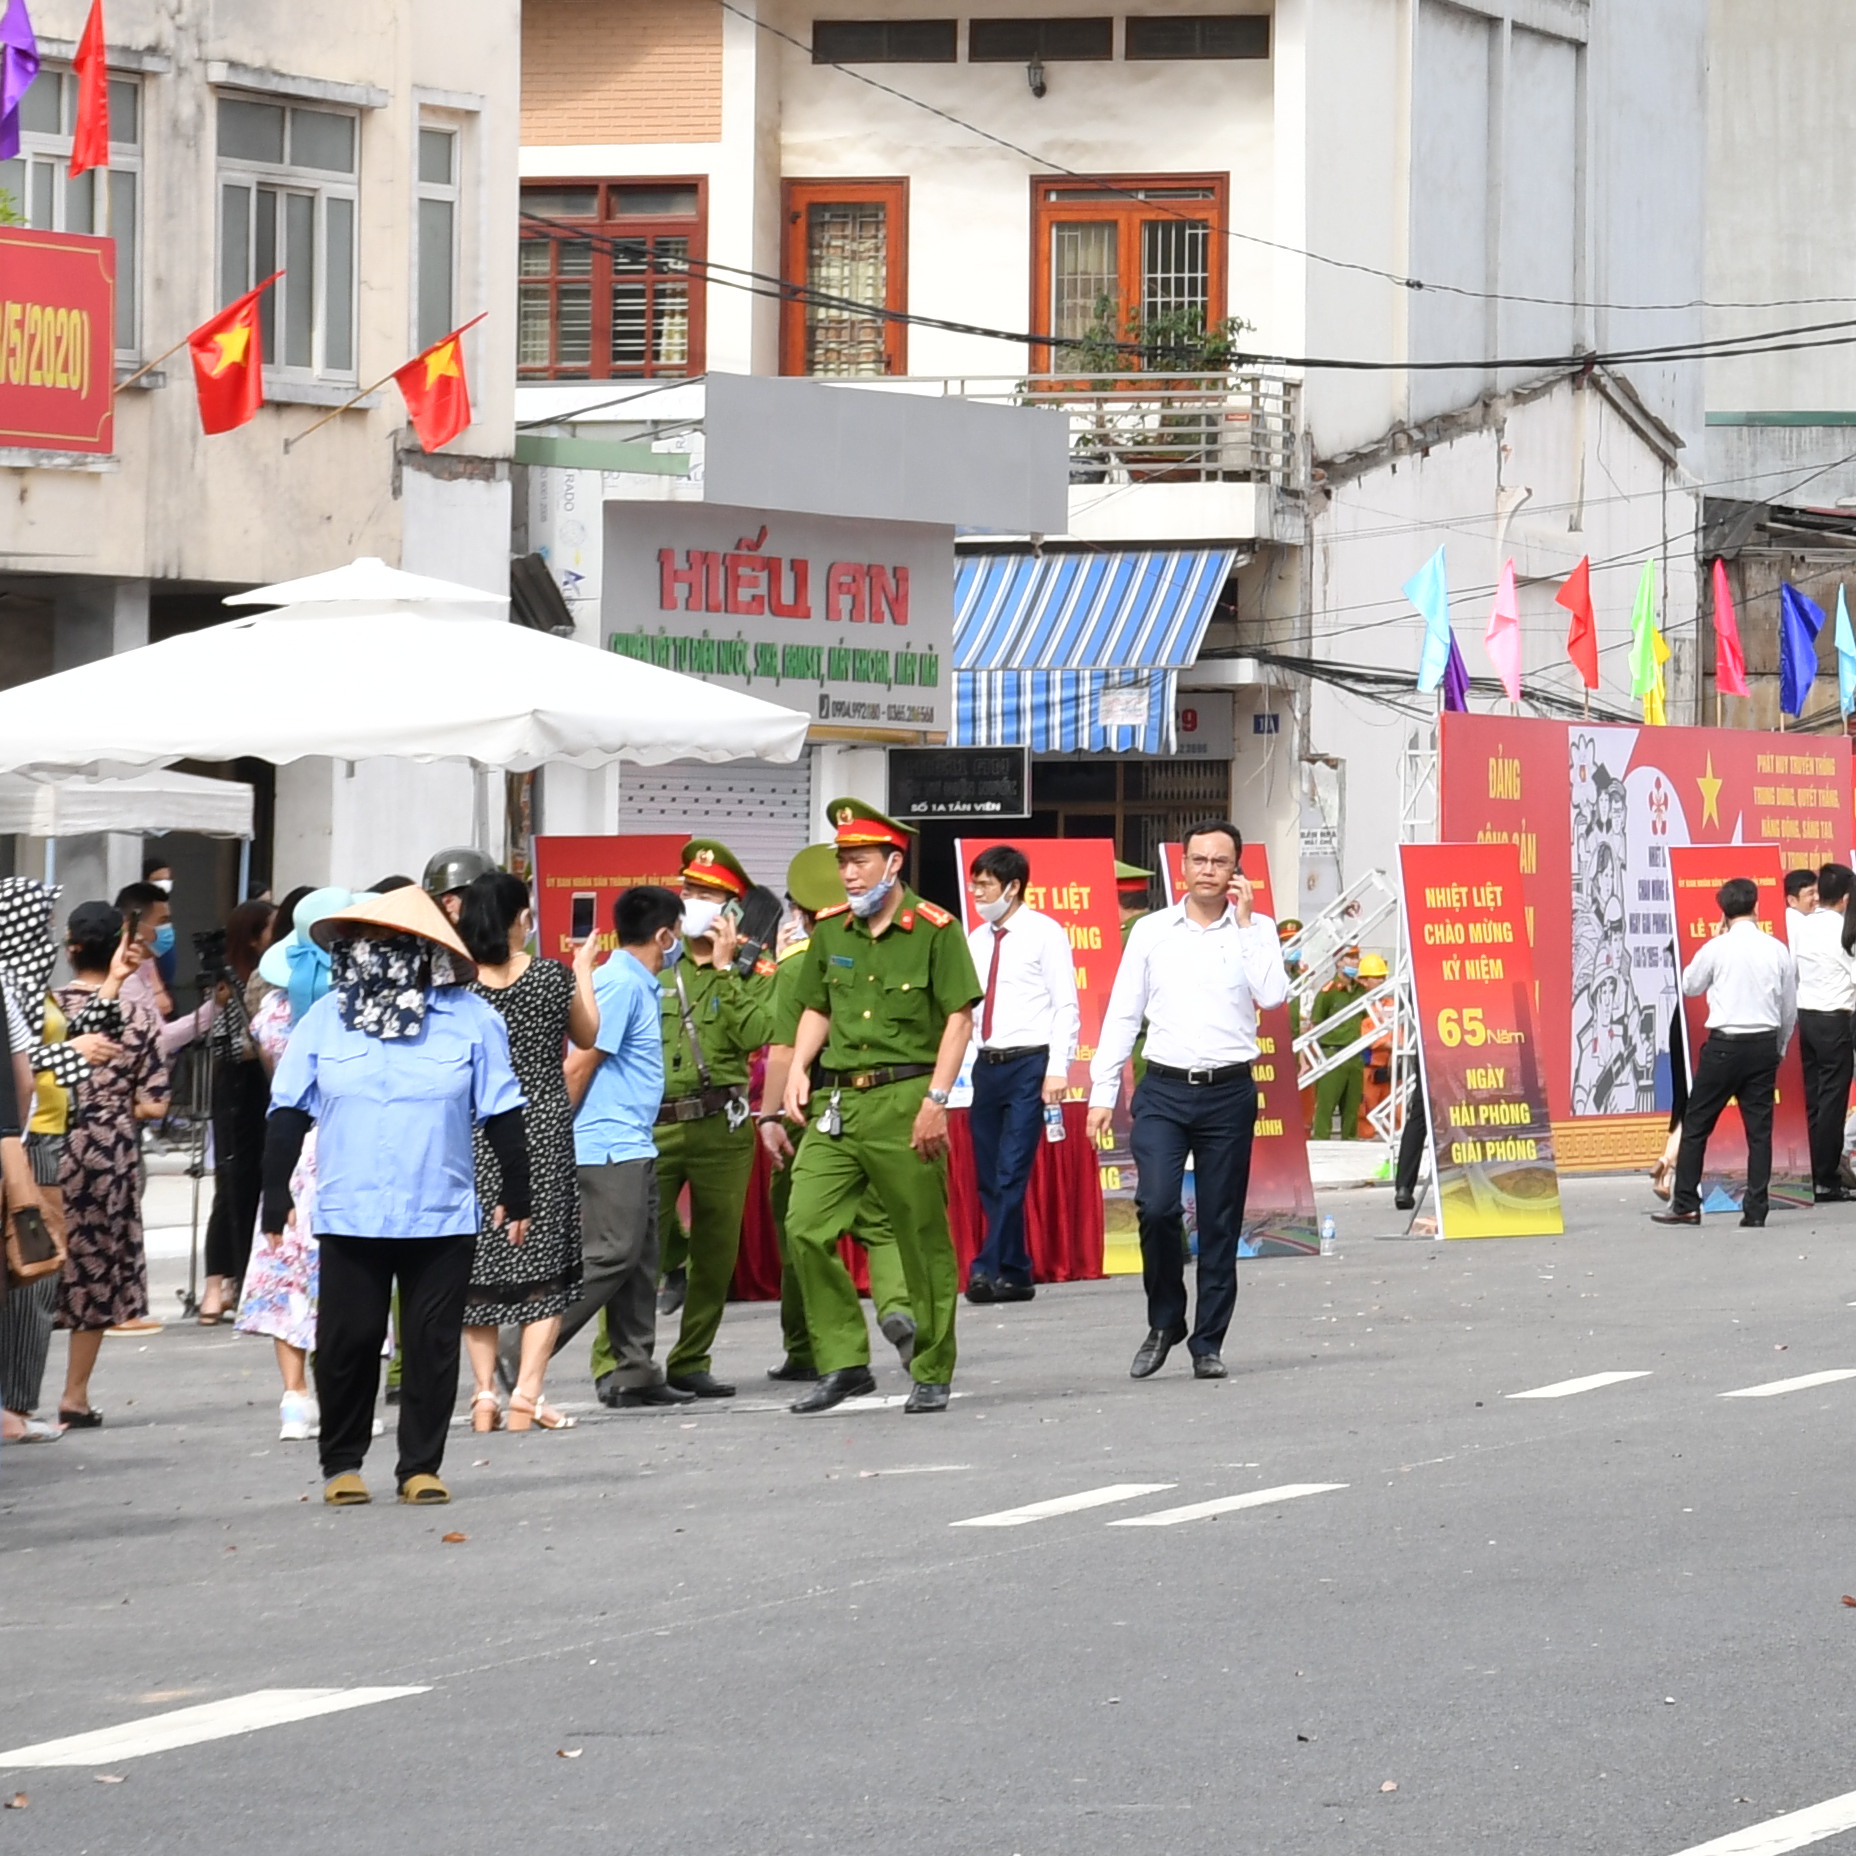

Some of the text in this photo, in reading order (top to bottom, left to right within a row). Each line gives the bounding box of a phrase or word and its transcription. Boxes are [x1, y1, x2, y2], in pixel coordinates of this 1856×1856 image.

[0, 300, 90, 401] /5/2020)
[658, 525, 811, 619] HIẾU
[826, 561, 909, 625] AN
[1489, 744, 1521, 801] ĐẢNG
[1425, 881, 1504, 913] NHIỆT LIỆT
[1423, 918, 1513, 945] CHÀO MỪNG
[1442, 953, 1504, 985] KỶ NIỆM
[1437, 1007, 1525, 1048] 65 Năm
[1466, 1062, 1505, 1090] NGÀY
[1449, 1098, 1531, 1127] HẢI PHÒNG
[1451, 1134, 1537, 1164] GIẢI PHÓNG
